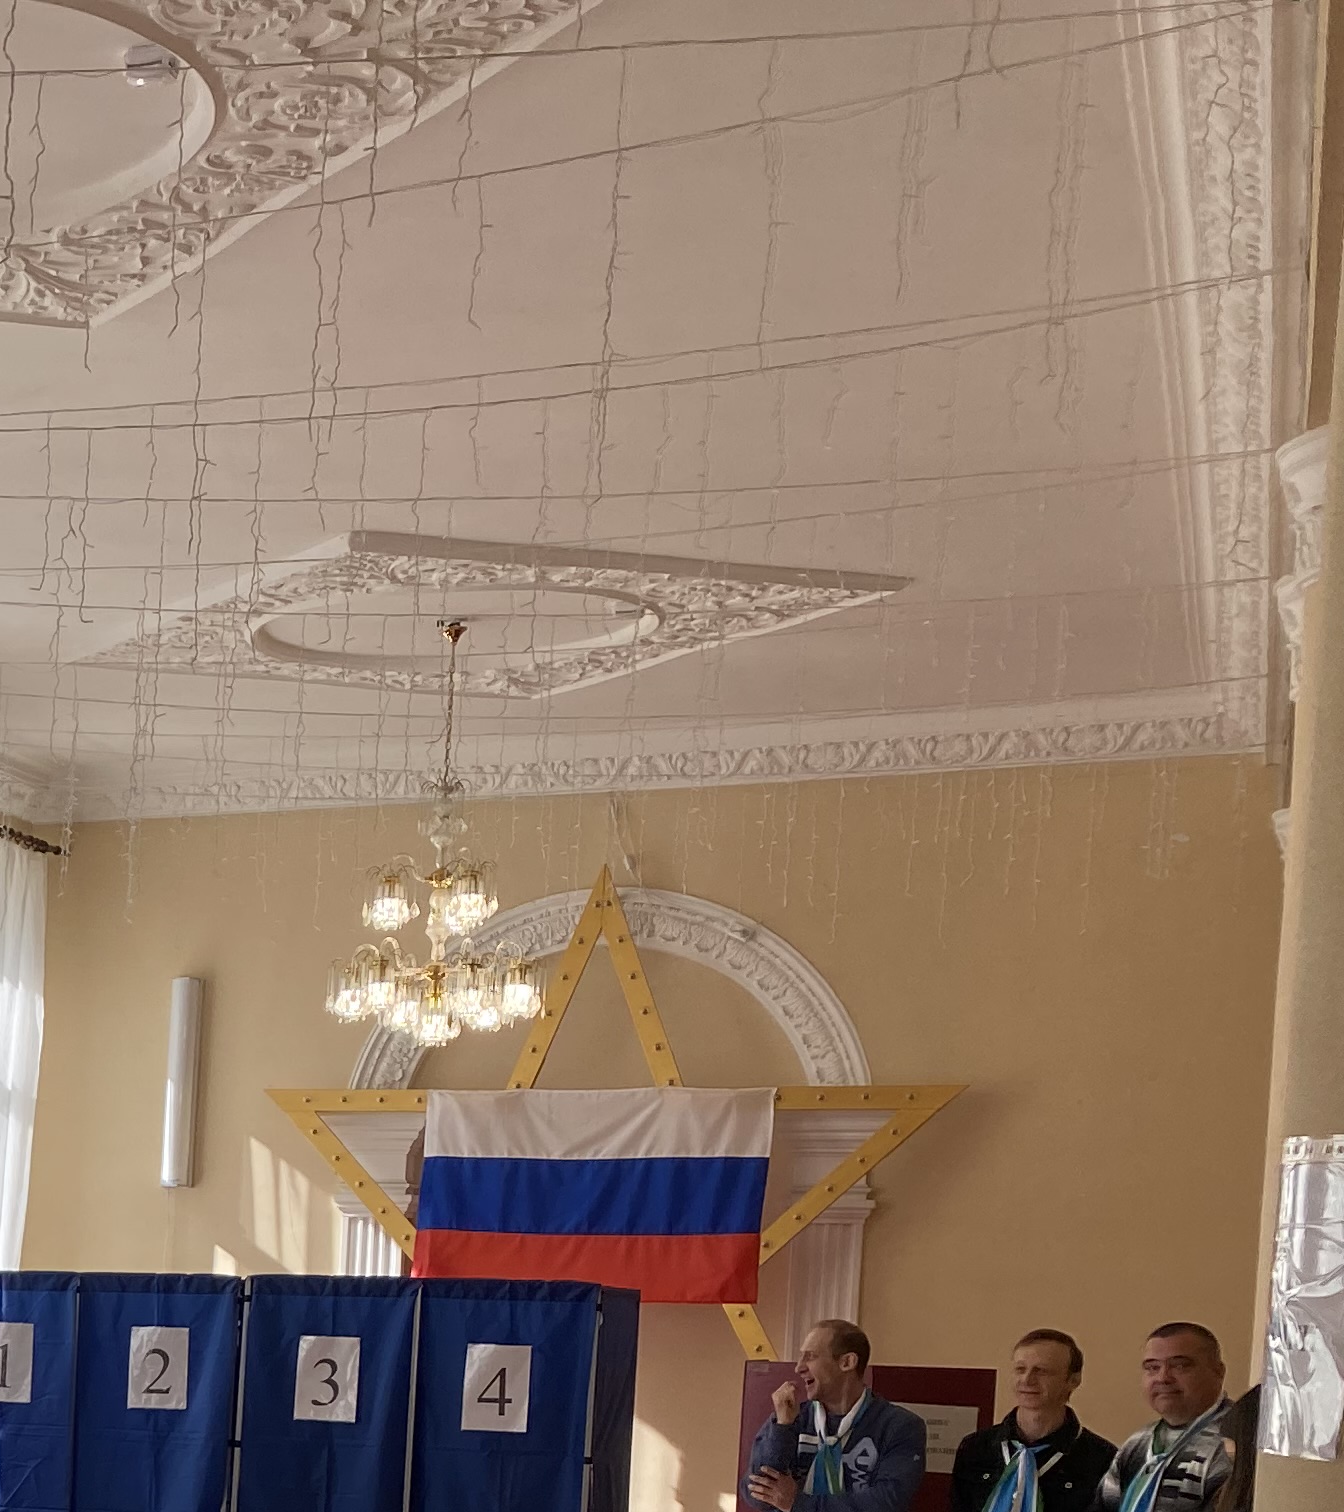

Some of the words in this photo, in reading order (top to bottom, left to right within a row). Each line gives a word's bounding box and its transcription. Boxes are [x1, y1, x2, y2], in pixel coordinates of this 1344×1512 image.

[142, 1348, 172, 1394] 2
[311, 1358, 339, 1406] 3
[477, 1367, 512, 1416] 4
